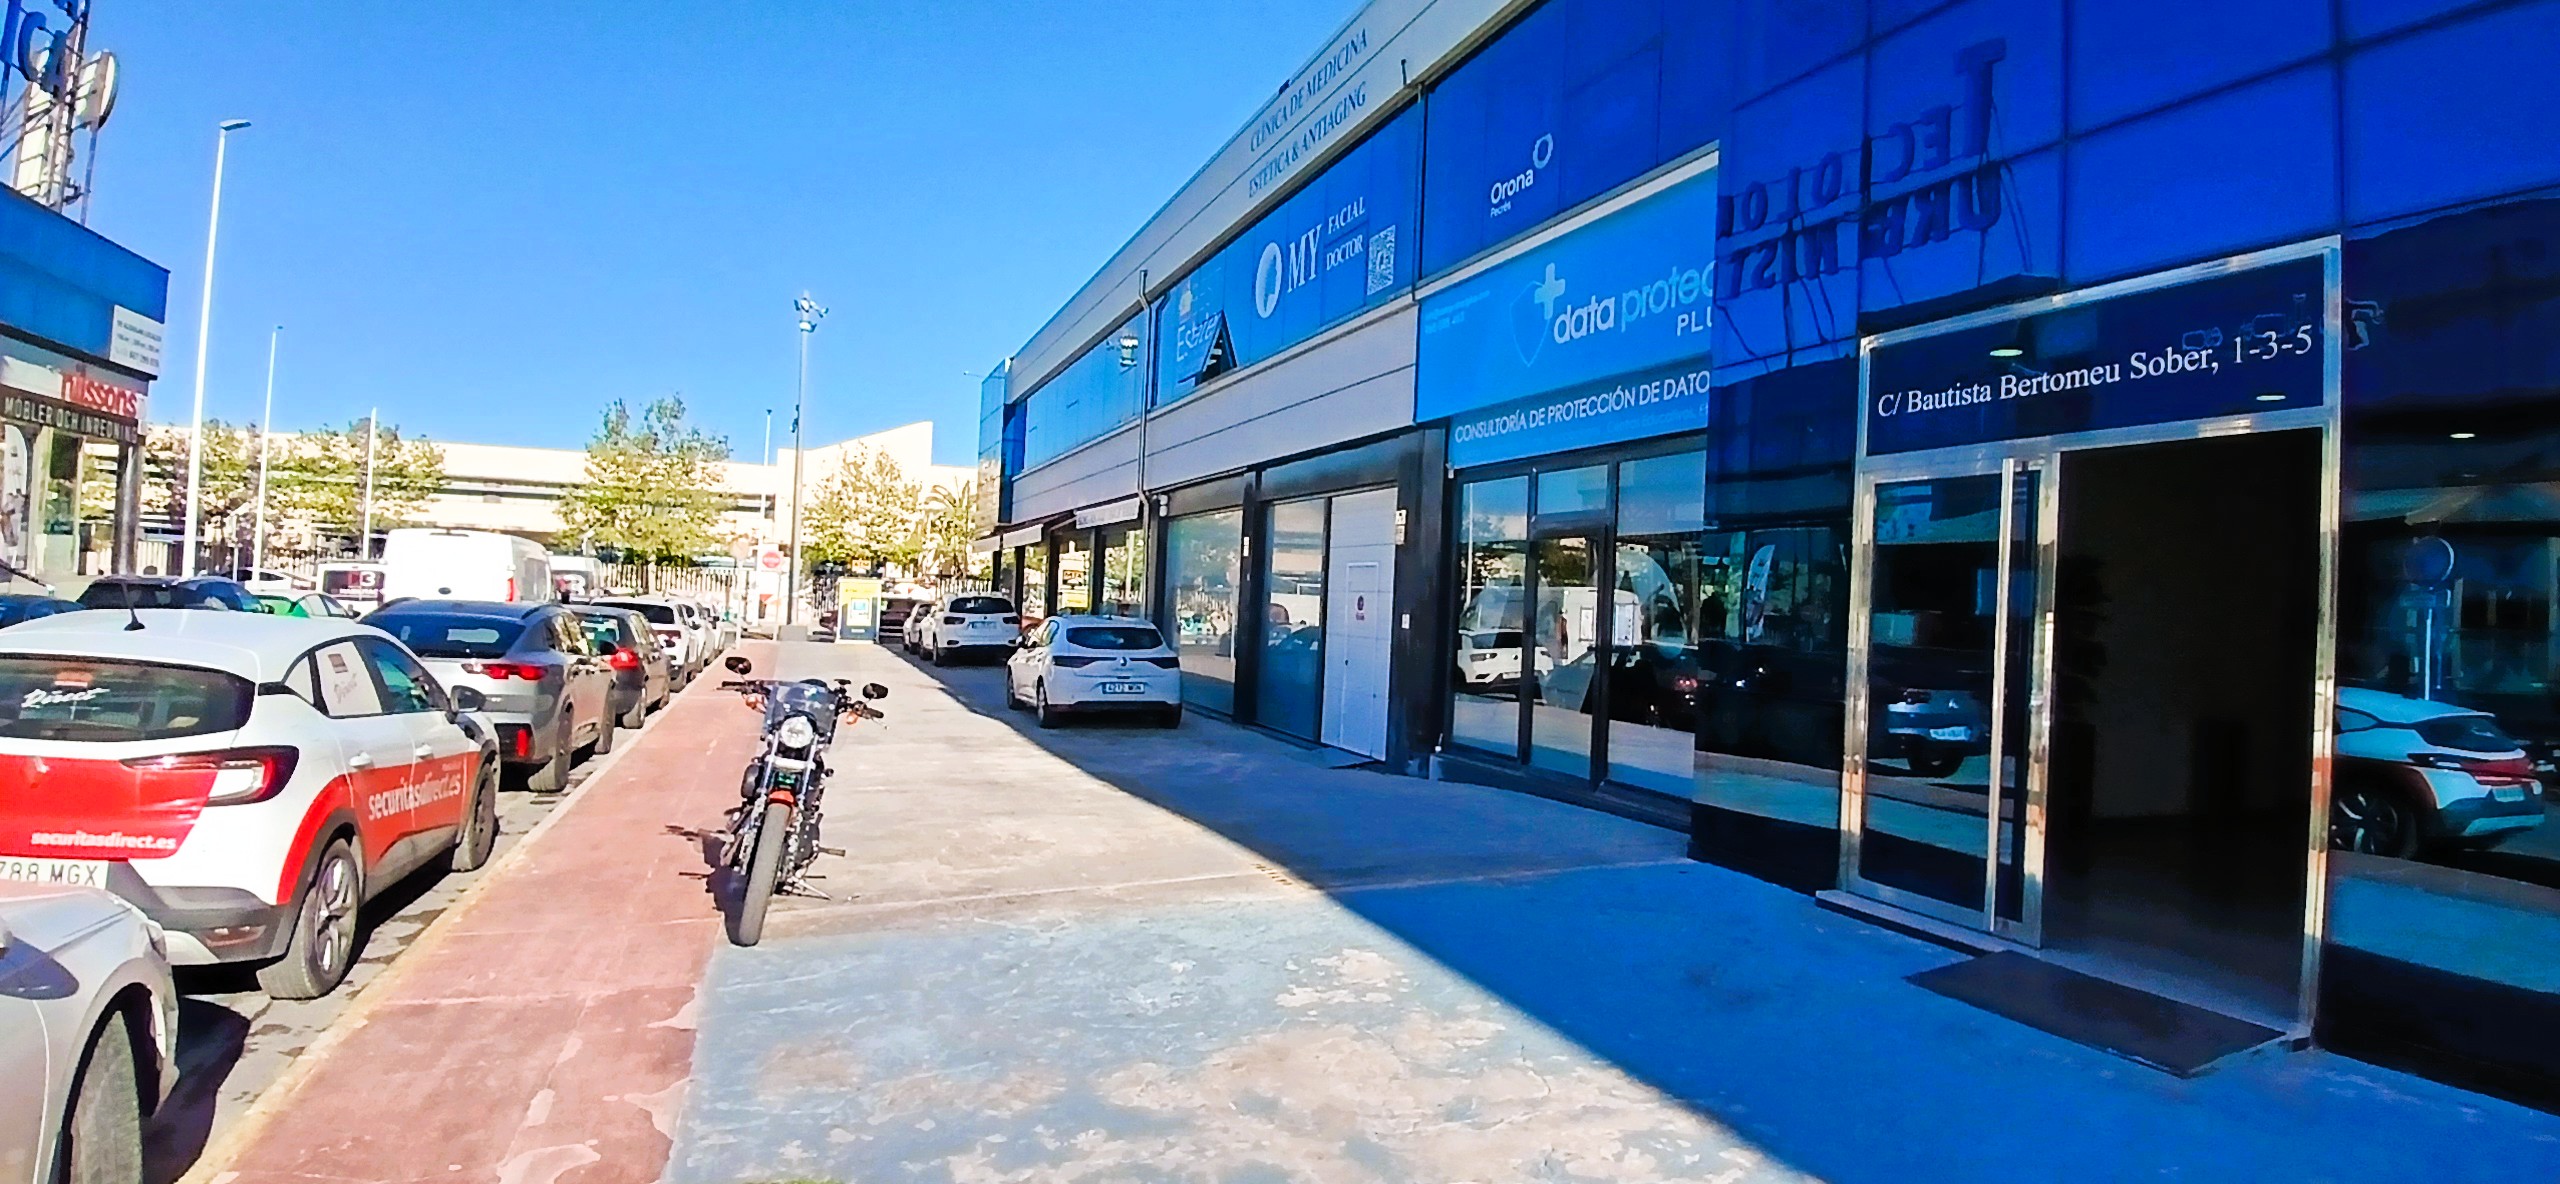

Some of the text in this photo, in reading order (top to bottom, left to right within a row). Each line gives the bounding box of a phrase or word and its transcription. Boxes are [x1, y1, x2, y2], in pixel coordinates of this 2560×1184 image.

[1290, 86, 1304, 117] DE
[1306, 27, 1367, 100] MEDICINA
[1291, 140, 1299, 162] &
[1302, 81, 1366, 151] ANTIAGING
[1490, 168, 1534, 205] Orona
[1328, 196, 1365, 235] FACIAL
[1287, 223, 1322, 293] MY
[1326, 233, 1363, 271] DOCTOR
[1553, 294, 1616, 344] data
[1878, 324, 2312, 417] C/ Bautista Bertomeu Sober, 1-3-5
[1454, 408, 1528, 443] CONSULTORÍA
[1529, 407, 1546, 427] DE
[1548, 385, 1635, 424] PROTECCIÓN
[1639, 381, 1661, 406] DE
[368, 770, 462, 821] securitasdirect.es
[31, 830, 177, 850] securitasdirect.es
[50, 863, 99, 886] MGX
